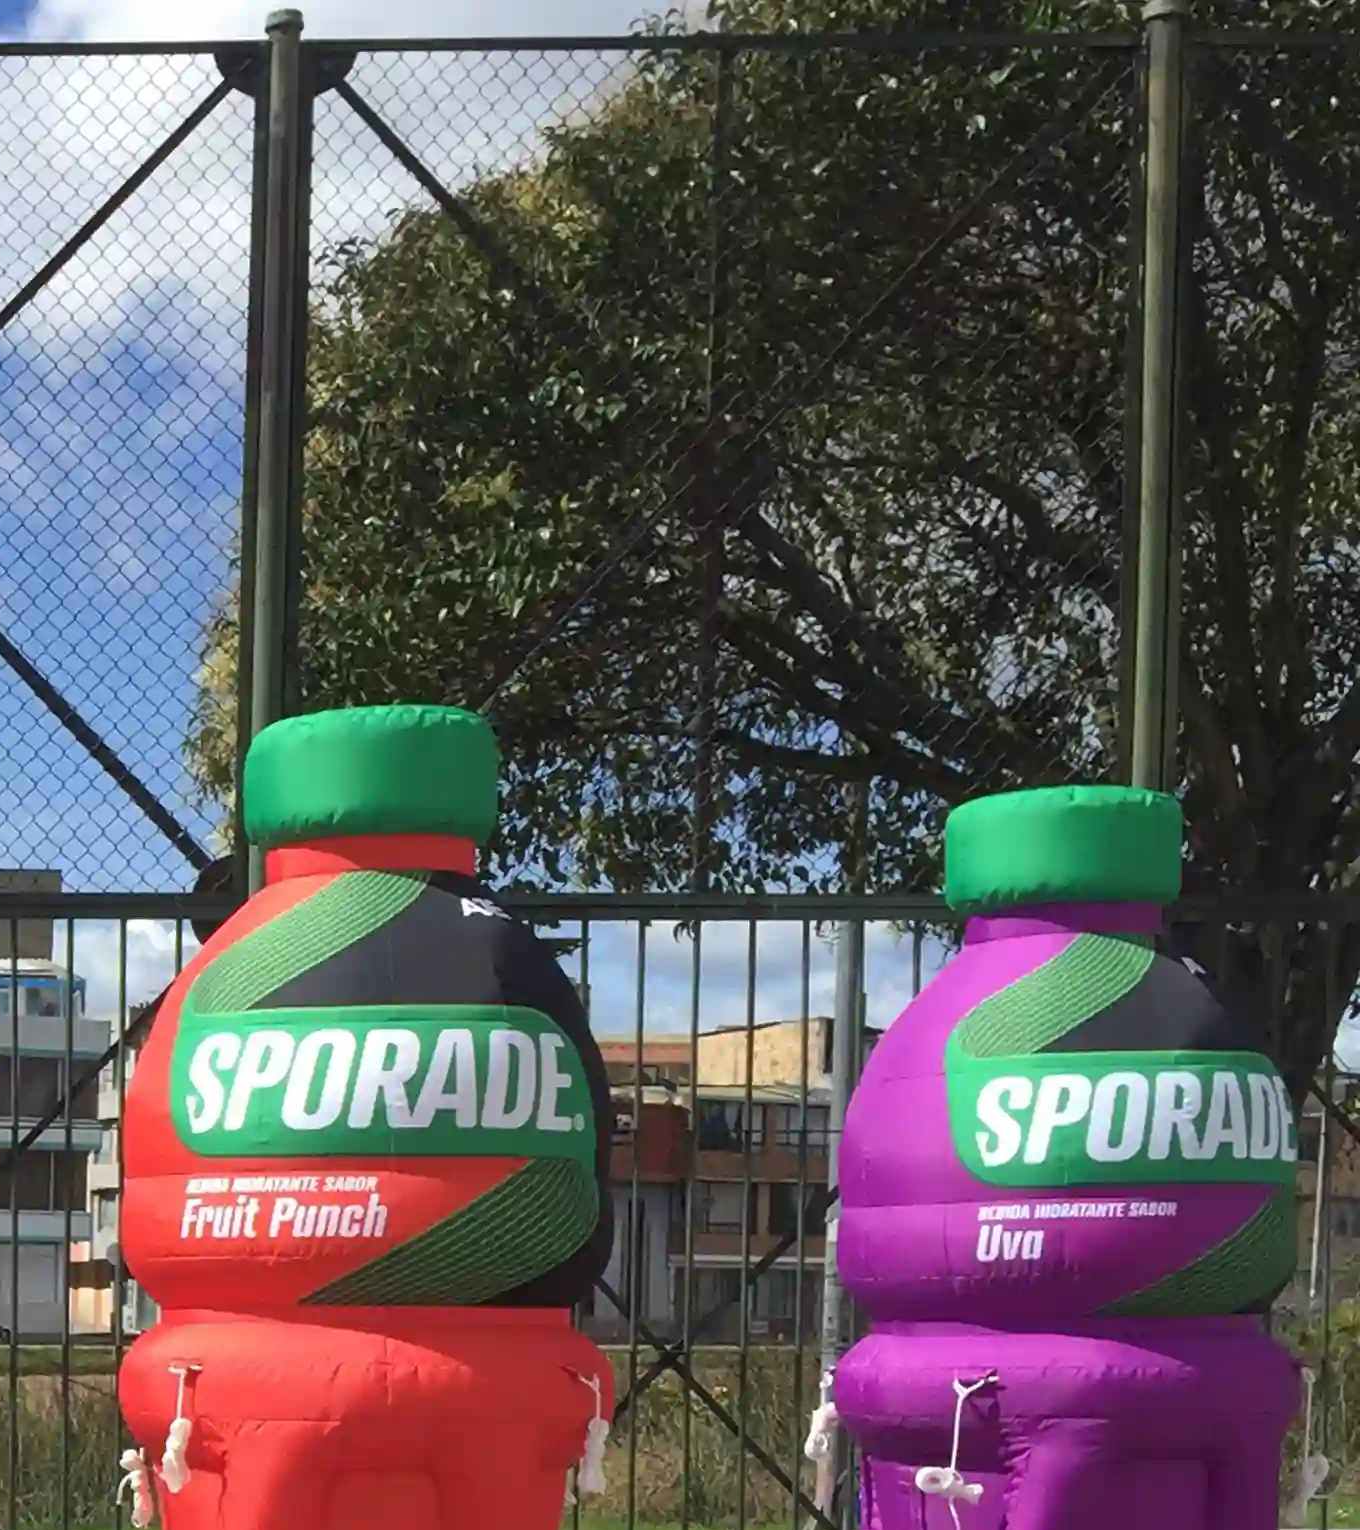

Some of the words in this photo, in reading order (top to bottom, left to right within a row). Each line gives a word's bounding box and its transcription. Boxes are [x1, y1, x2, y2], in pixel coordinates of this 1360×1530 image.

[185, 1028, 573, 1134] SPORADE
[975, 1071, 1298, 1168] SPORADE
[322, 1176, 379, 1192] SABOR
[180, 1194, 260, 1239] Fruit
[268, 1193, 388, 1238] Punch
[1128, 1202, 1178, 1217] SABOR
[976, 1224, 1045, 1263] Uva
